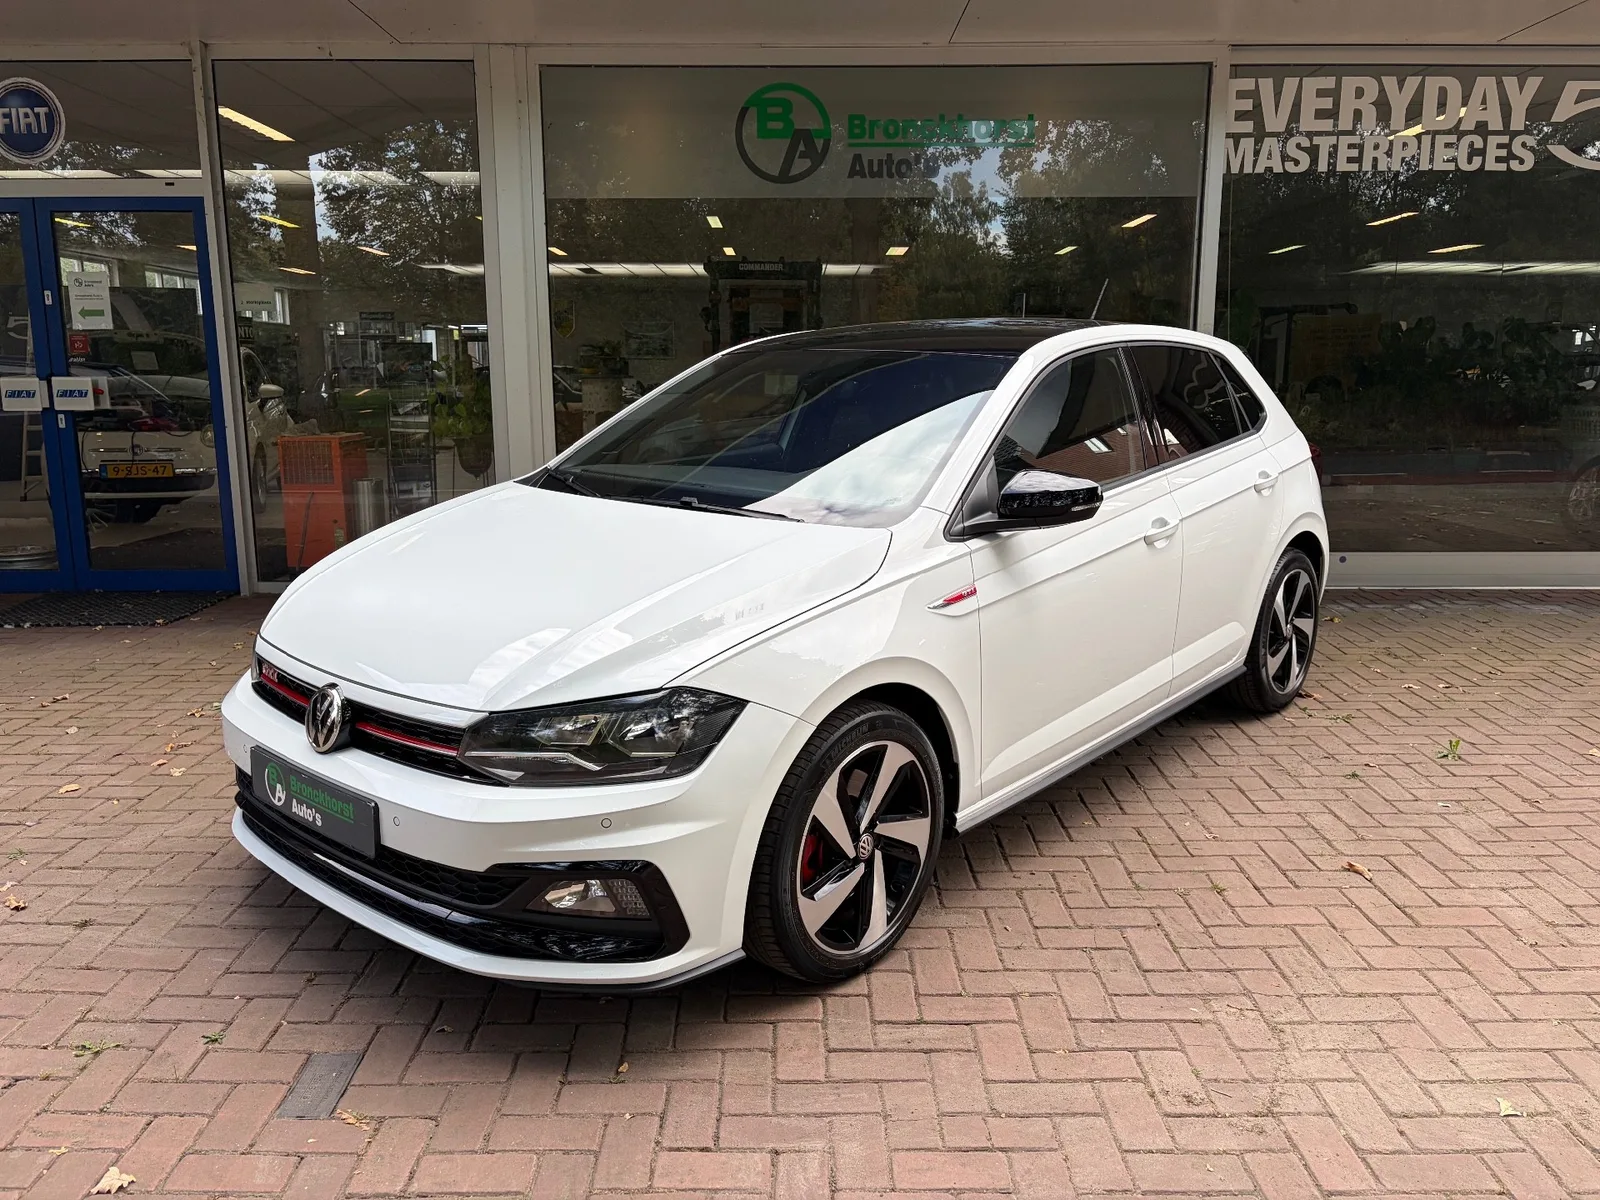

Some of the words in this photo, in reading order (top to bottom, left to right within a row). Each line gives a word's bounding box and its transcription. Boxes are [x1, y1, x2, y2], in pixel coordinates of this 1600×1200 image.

[1226, 76, 1544, 133] EVERYDAY
[0, 107, 49, 134] FIAT
[847, 113, 1036, 140] Bronckhorst
[1224, 134, 1536, 174] MASTERPIECES
[738, 263, 784, 271] COMMANDER
[5, 389, 36, 398] FIAT
[56, 389, 89, 398] FIAT
[290, 776, 354, 818] Bronckhorst
[291, 798, 323, 827] Auto's
